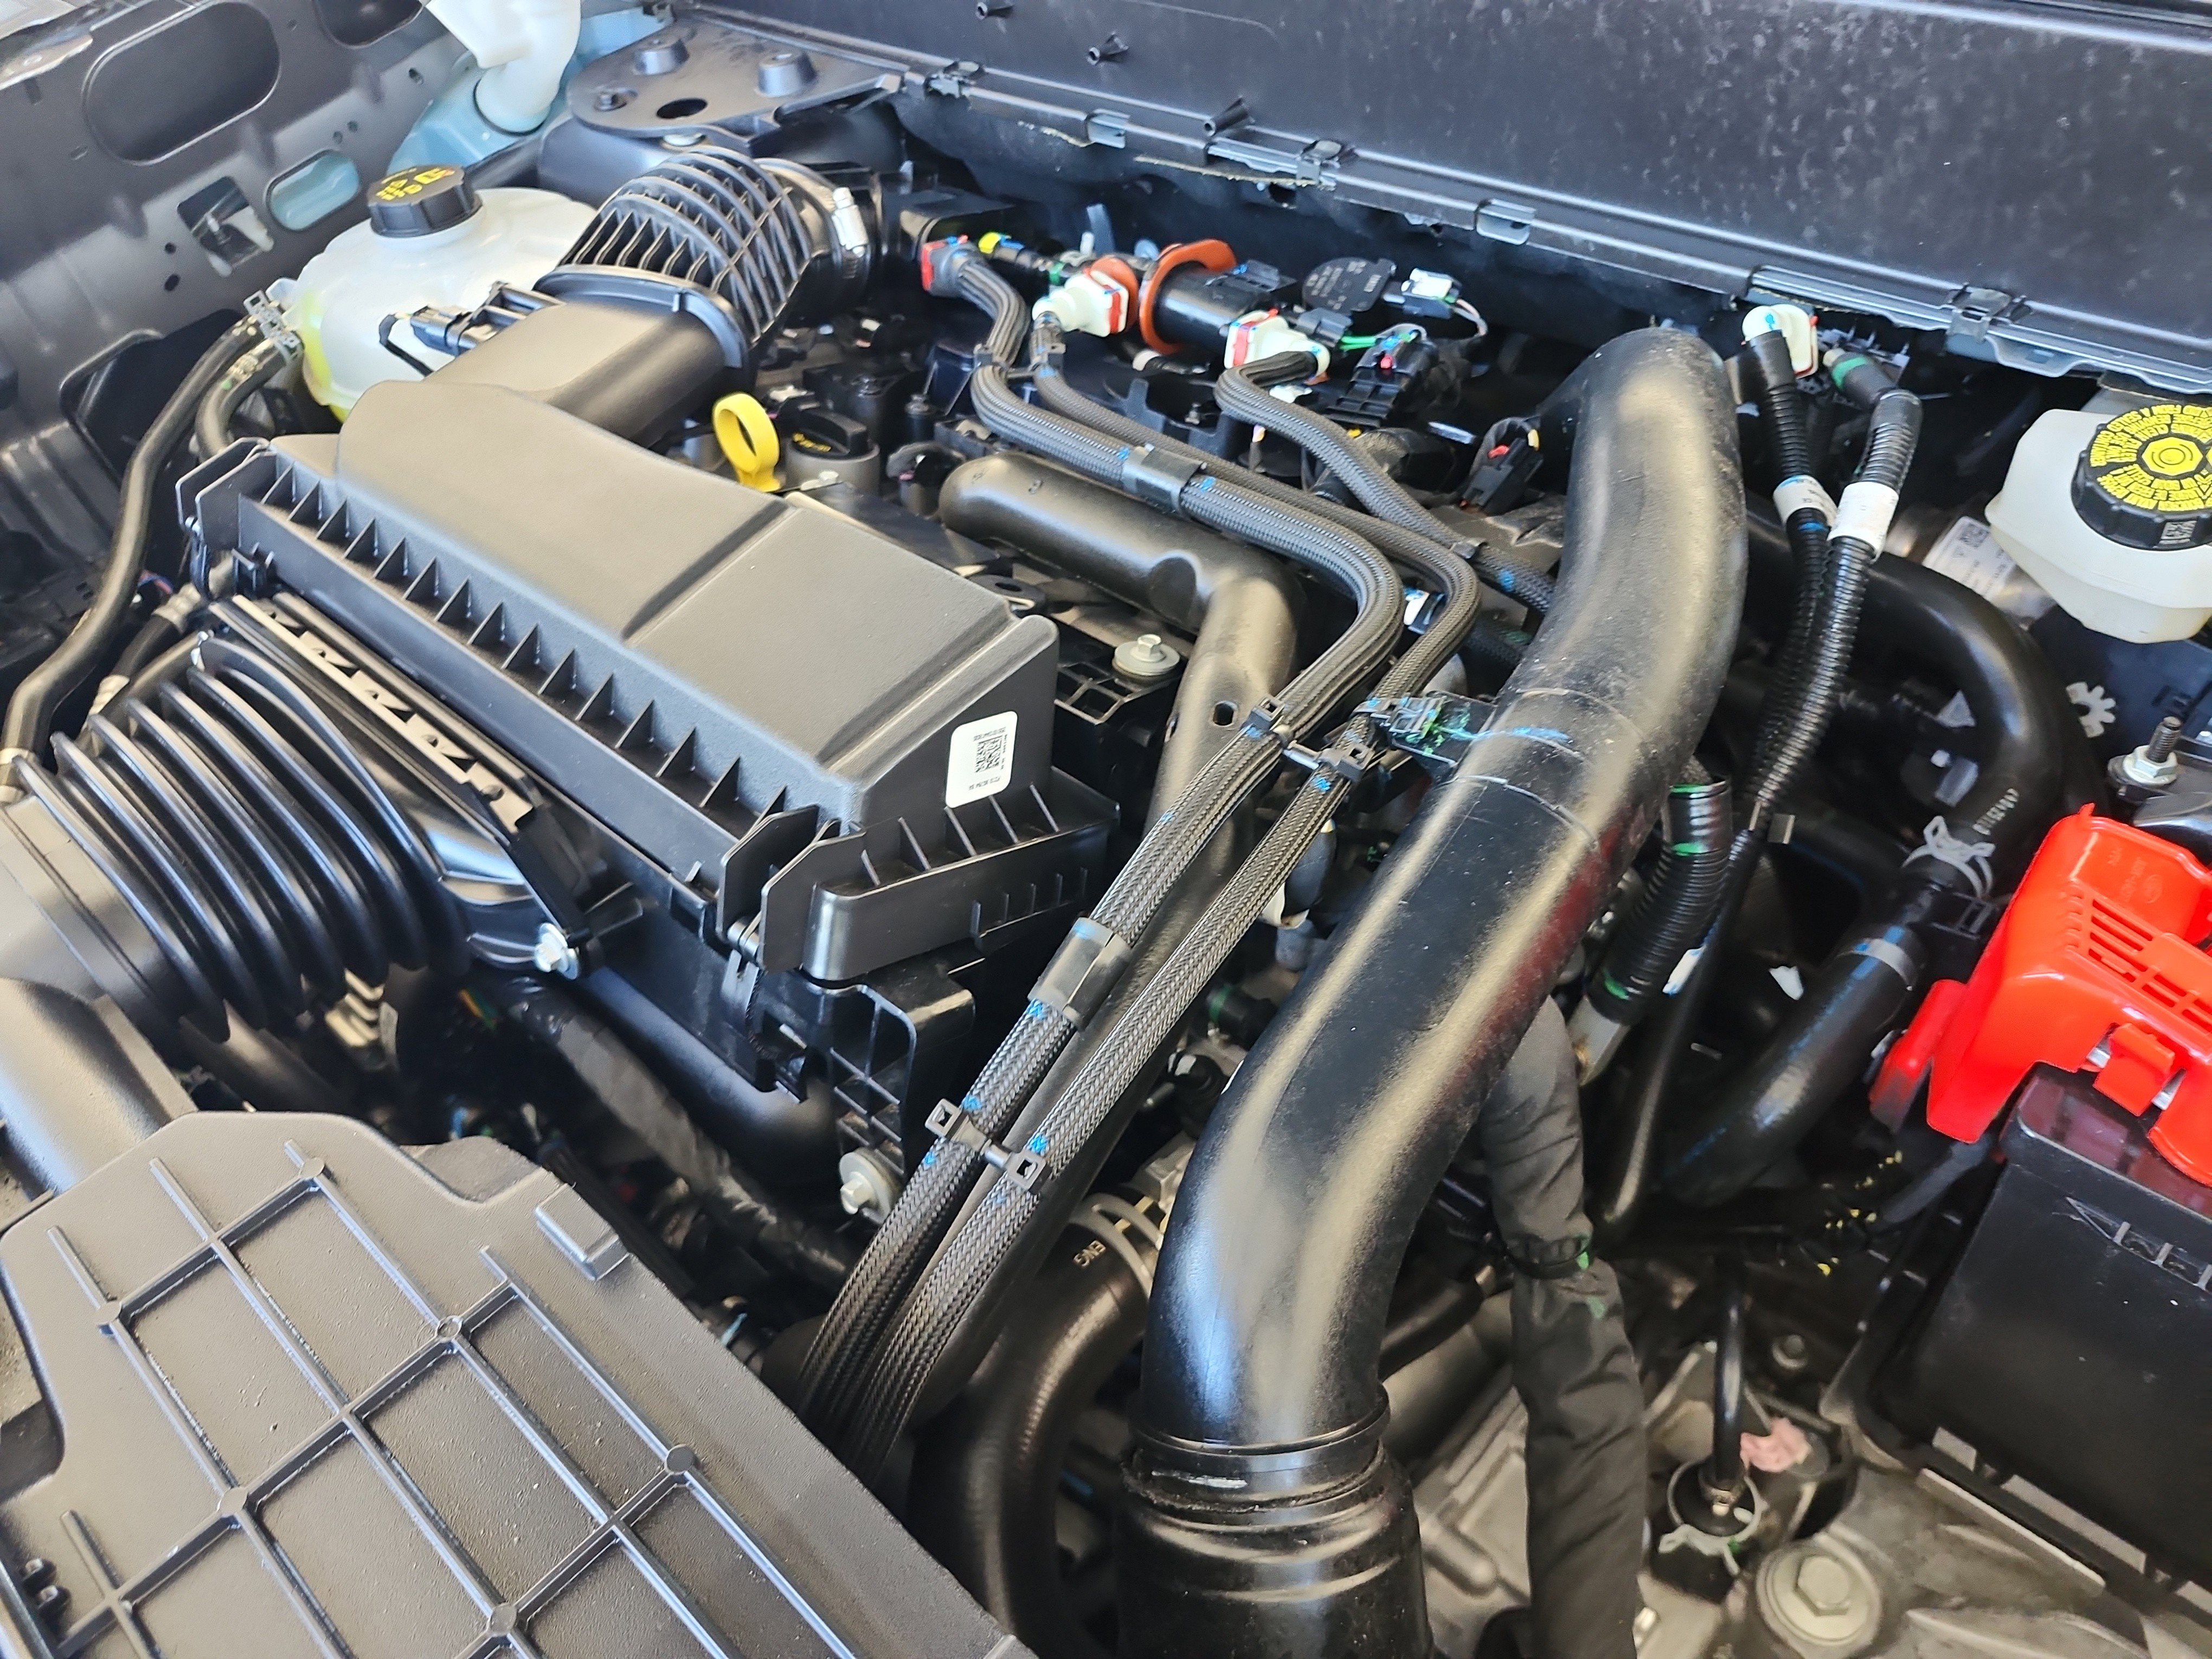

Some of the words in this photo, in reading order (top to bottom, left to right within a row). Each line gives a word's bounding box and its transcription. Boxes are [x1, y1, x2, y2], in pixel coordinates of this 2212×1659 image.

[2107, 411, 2142, 432] SEALED
[2090, 430, 2115, 467] CONTAINER
[1074, 1240, 1106, 1266] ENG
